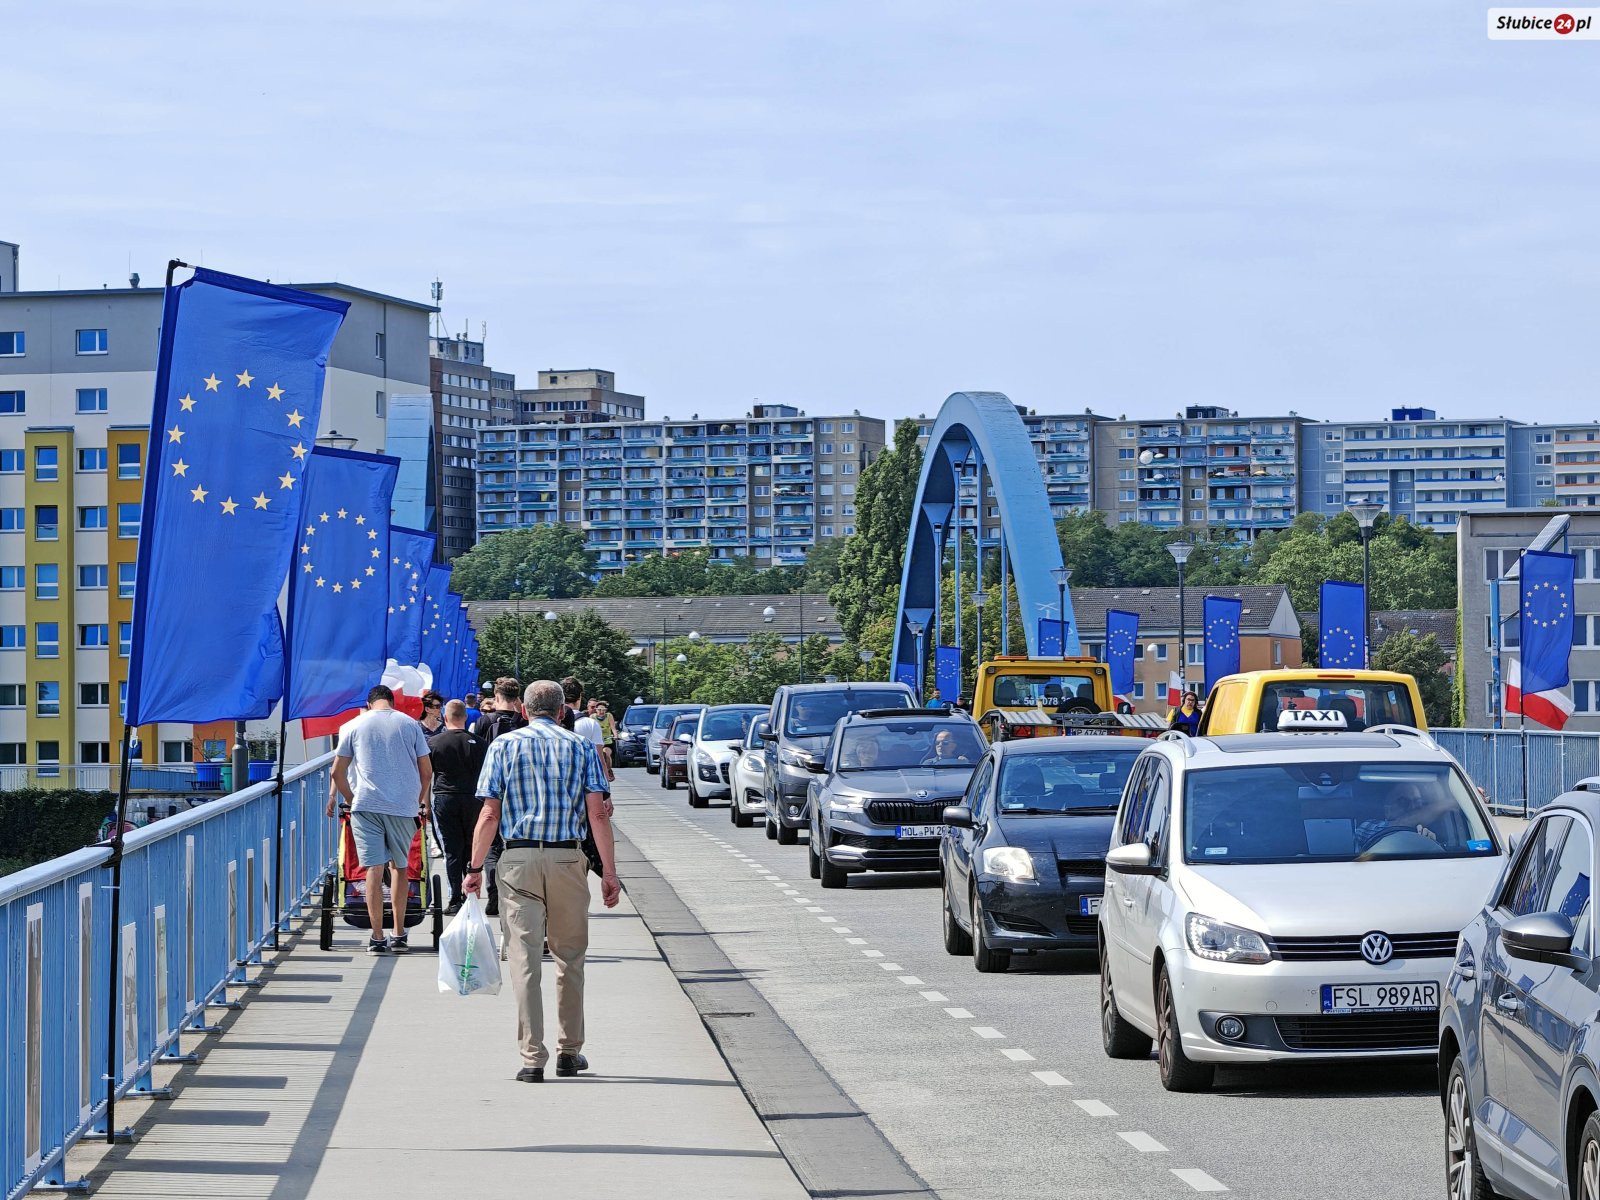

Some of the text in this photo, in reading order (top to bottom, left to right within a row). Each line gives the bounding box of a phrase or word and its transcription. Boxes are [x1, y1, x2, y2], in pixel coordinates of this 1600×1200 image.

[1042, 697, 1058, 706] 078
[1288, 710, 1339, 721] TAXI
[901, 827, 918, 836] MOL
[1333, 985, 1436, 1007] FSL 989AR
